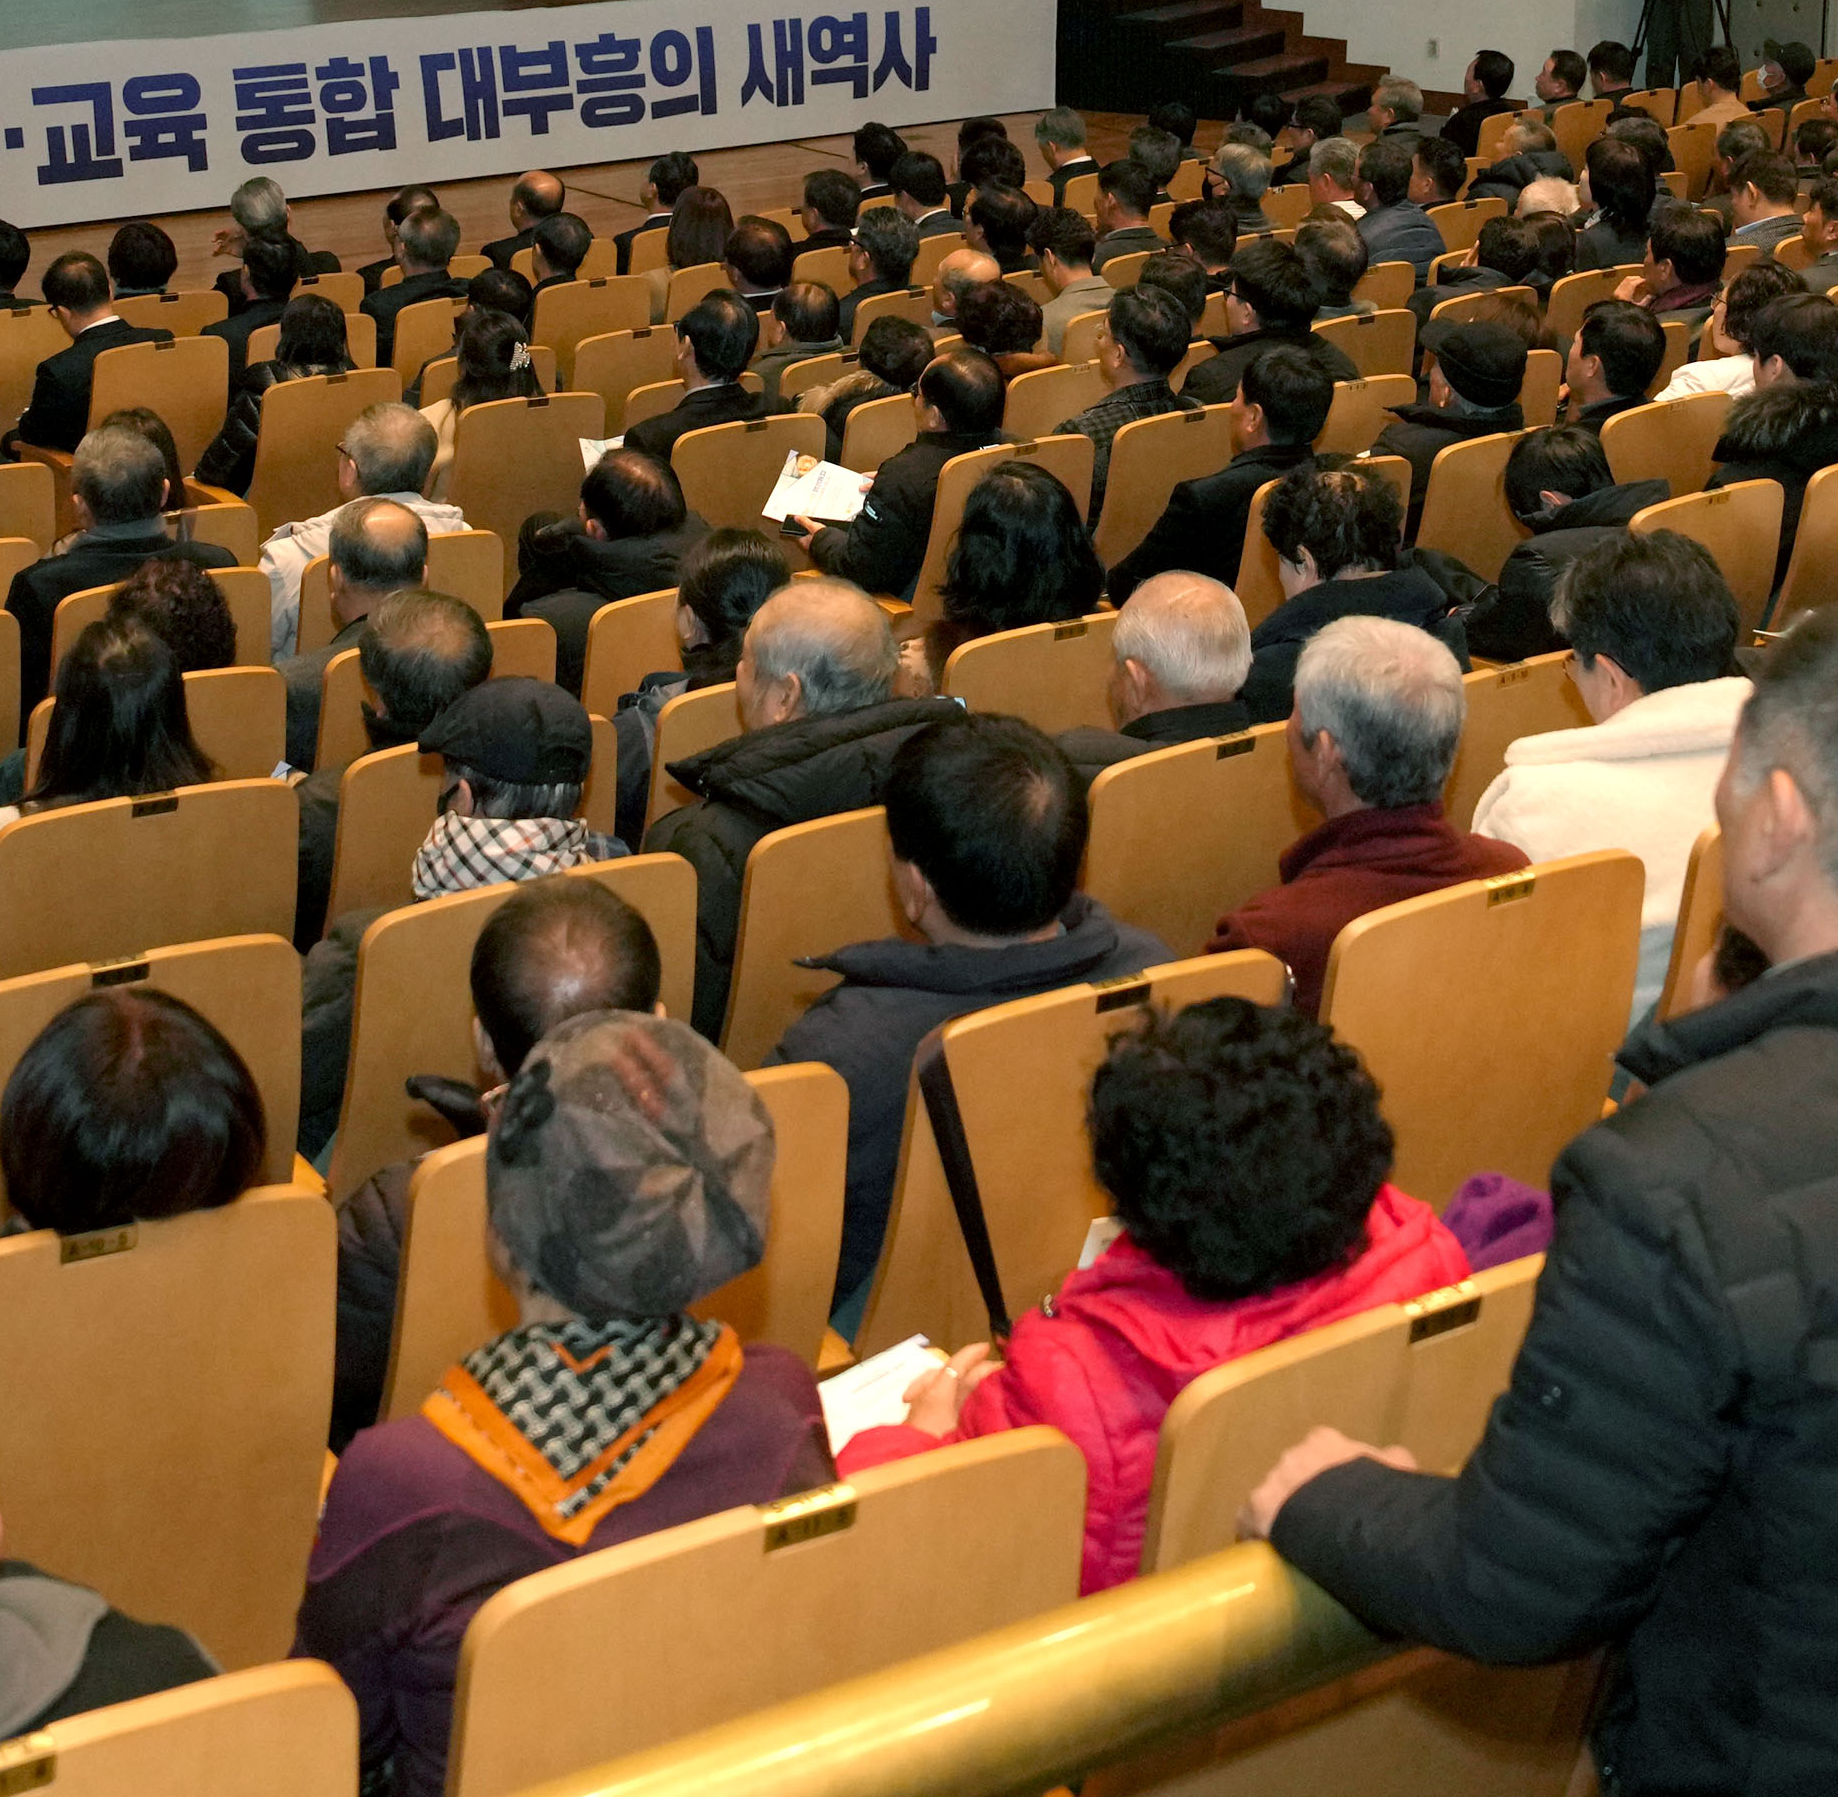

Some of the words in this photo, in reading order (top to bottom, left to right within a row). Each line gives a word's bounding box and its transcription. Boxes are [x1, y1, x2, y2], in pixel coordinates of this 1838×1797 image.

[234, 53, 400, 163] 통합
[420, 23, 718, 143] 대부흥의
[739, 5, 939, 110] 새역사
